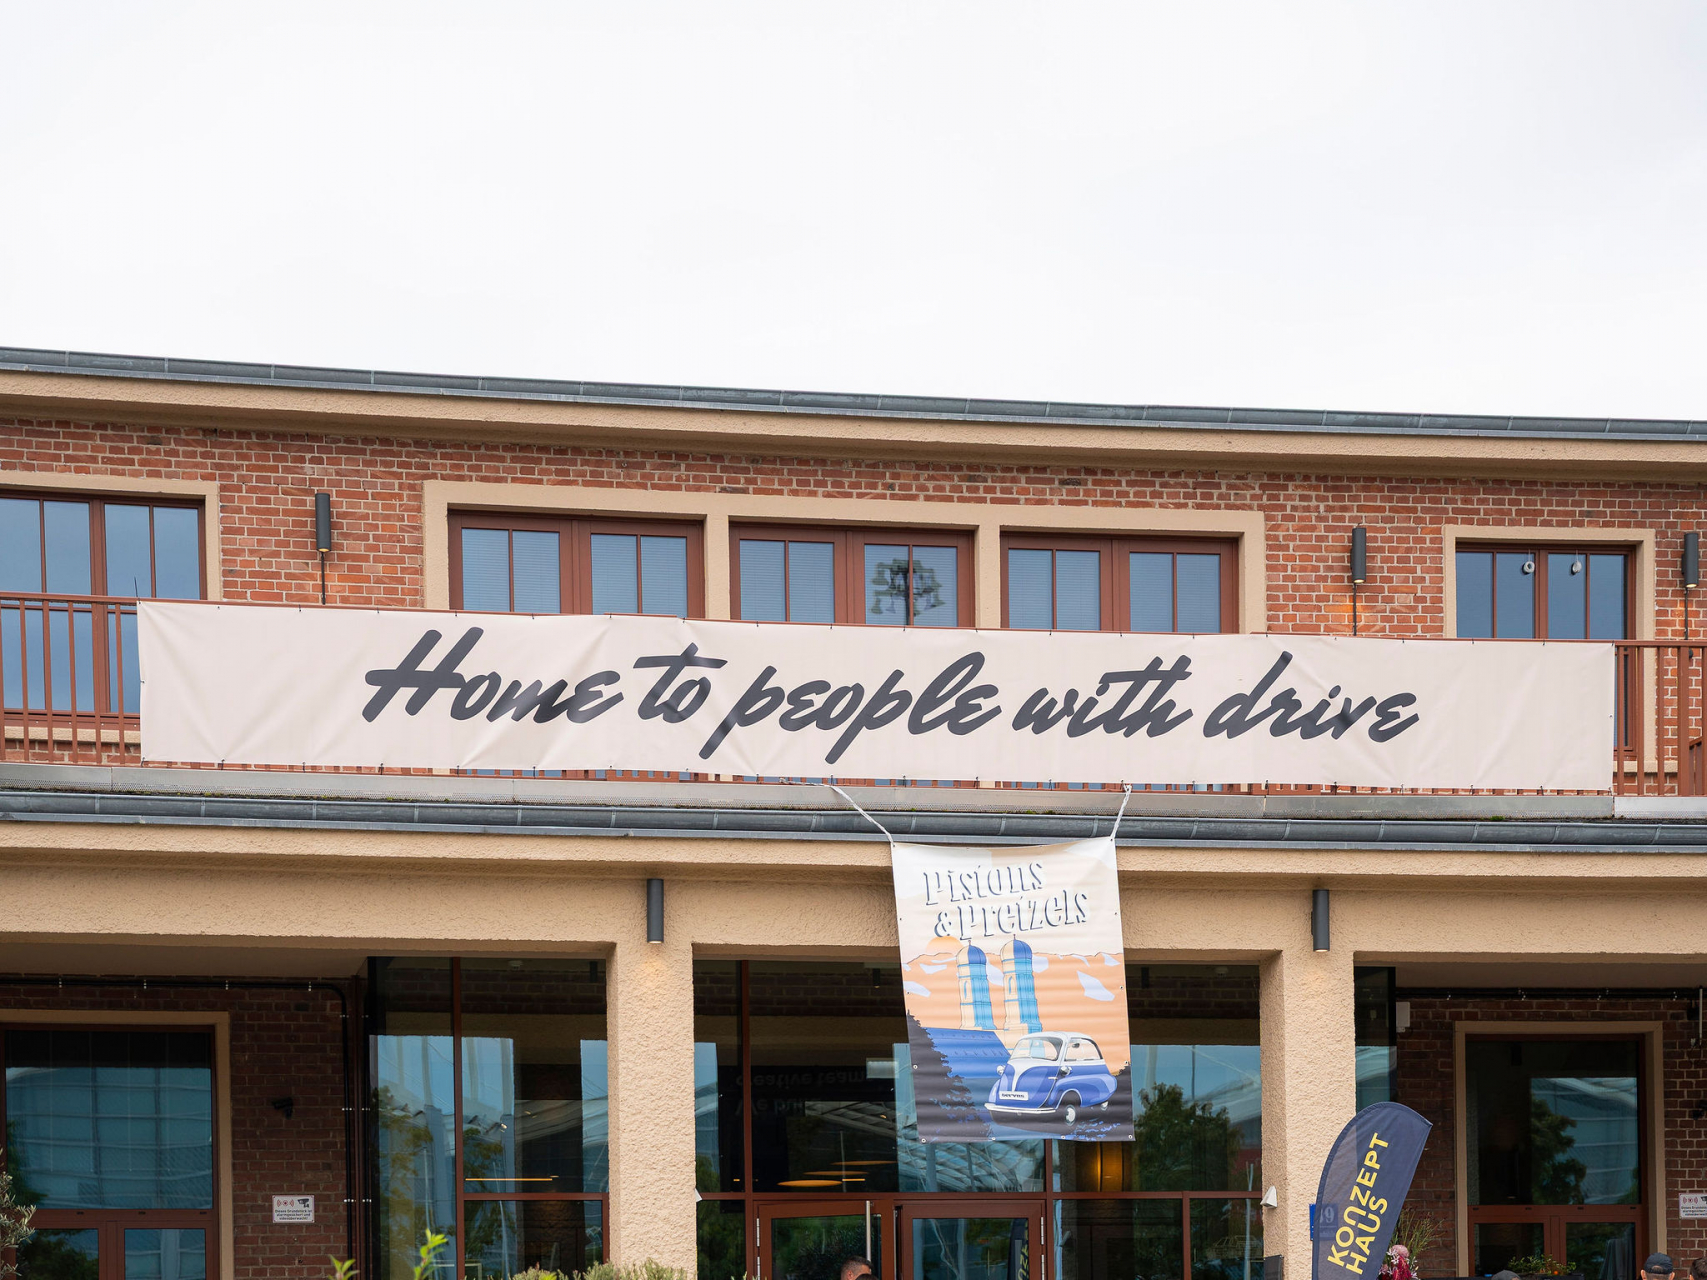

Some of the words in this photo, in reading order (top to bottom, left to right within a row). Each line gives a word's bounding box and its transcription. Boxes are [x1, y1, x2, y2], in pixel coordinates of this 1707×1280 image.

[362, 626, 624, 723] Home
[633, 642, 727, 723] to
[698, 651, 1002, 764] people
[1011, 654, 1194, 738] with
[1202, 650, 1420, 743] drive
[923, 862, 1043, 906] Pistons
[1327, 1132, 1389, 1267] KONZEPT
[1346, 1195, 1389, 1275] HAUS
